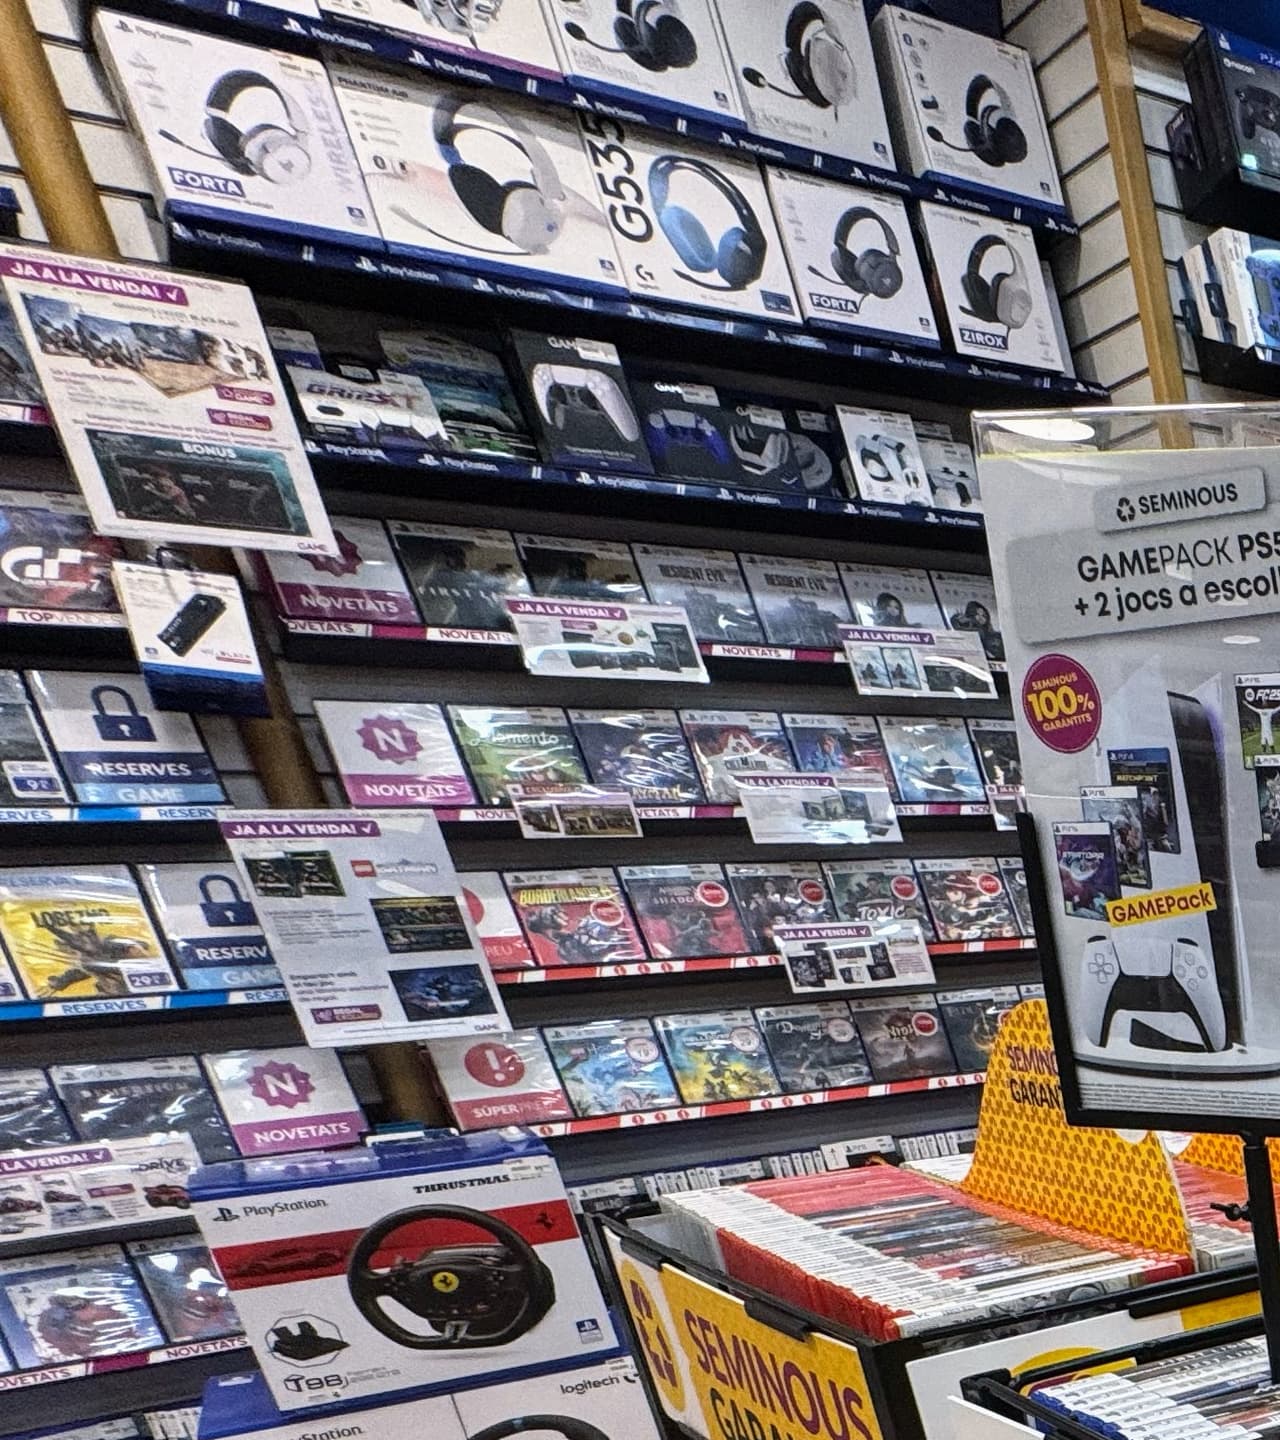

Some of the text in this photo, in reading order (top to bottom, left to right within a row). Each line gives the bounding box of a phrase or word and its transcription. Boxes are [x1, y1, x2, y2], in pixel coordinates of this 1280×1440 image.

[172, 170, 243, 195] FORTA
[580, 112, 653, 243] G535
[11, 262, 160, 299] JA A LA VENDA!
[811, 295, 857, 313] FORTA
[961, 330, 1005, 348] ZIROX
[181, 442, 237, 461] BONUS
[325, 446, 384, 461] PlayStation
[597, 477, 647, 491] PlayStation
[1138, 482, 1239, 517] SEMINOUS
[861, 507, 903, 520] PlayStation
[941, 515, 981, 527] PlayStation
[1077, 536, 1232, 584] GAMEPACK
[302, 593, 399, 614] NOVETATS
[516, 602, 610, 618] JA A LA VENDA!
[1074, 598, 1090, 617] +
[1093, 592, 1112, 618] 2
[1115, 582, 1173, 621] jocs
[1178, 584, 1198, 604] a
[439, 628, 513, 644] NOVETATS
[722, 646, 782, 659] NOVETATS
[1031, 671, 1079, 692] SEMINOUS
[1026, 687, 1096, 722] 100%
[1042, 712, 1093, 733] GARANTITS
[90, 763, 192, 778] RESERVES
[365, 783, 457, 799] NOVETATS
[231, 821, 356, 835] JA A LA VENDA!
[1111, 890, 1213, 924] GAMEPack
[62, 1000, 147, 1014] RESERVES
[254, 1122, 352, 1145] NOVETATS
[25, 1152, 89, 1169] VENDA!
[243, 1198, 327, 1219] PlayStation
[166, 1338, 248, 1361] NOVETATS
[560, 1374, 620, 1395] logitech
